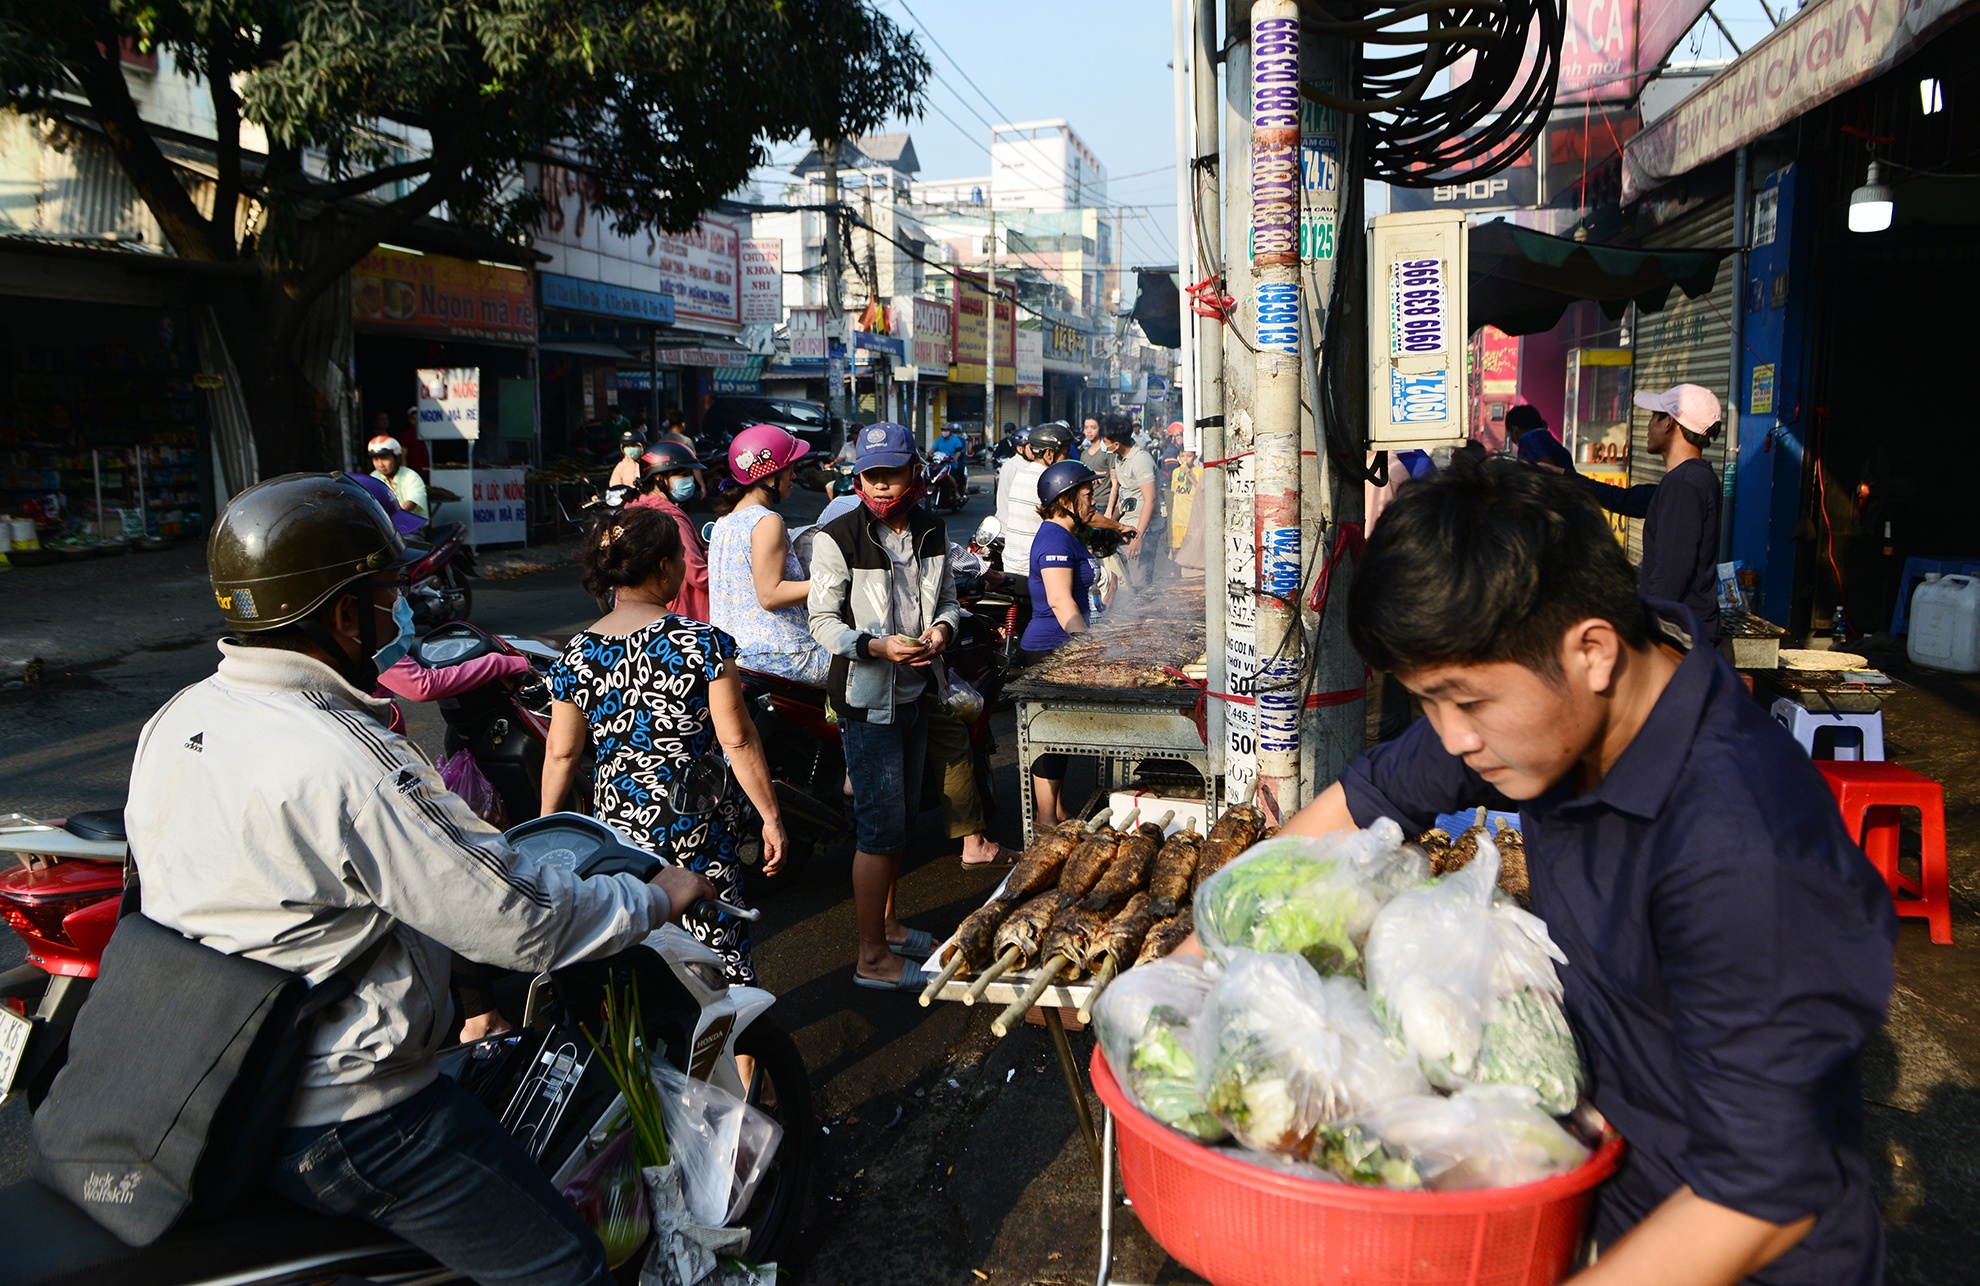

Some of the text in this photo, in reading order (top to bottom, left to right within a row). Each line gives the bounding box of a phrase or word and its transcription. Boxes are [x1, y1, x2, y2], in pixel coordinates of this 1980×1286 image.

[1561, 60, 1582, 76] nh
[1433, 178, 1508, 202] SHOP
[746, 266, 775, 275] KHOA
[752, 281, 771, 290] NHI
[419, 284, 475, 326] Ngon
[792, 311, 818, 332] IN
[915, 303, 948, 337] PHOTO
[793, 333, 829, 356] ẢN
[420, 409, 443, 422] NGON
[473, 508, 495, 523] NGON
[696, 1030, 723, 1049] HONDA
[89, 1171, 114, 1188] Jack
[83, 1184, 134, 1205] Wolfskin
